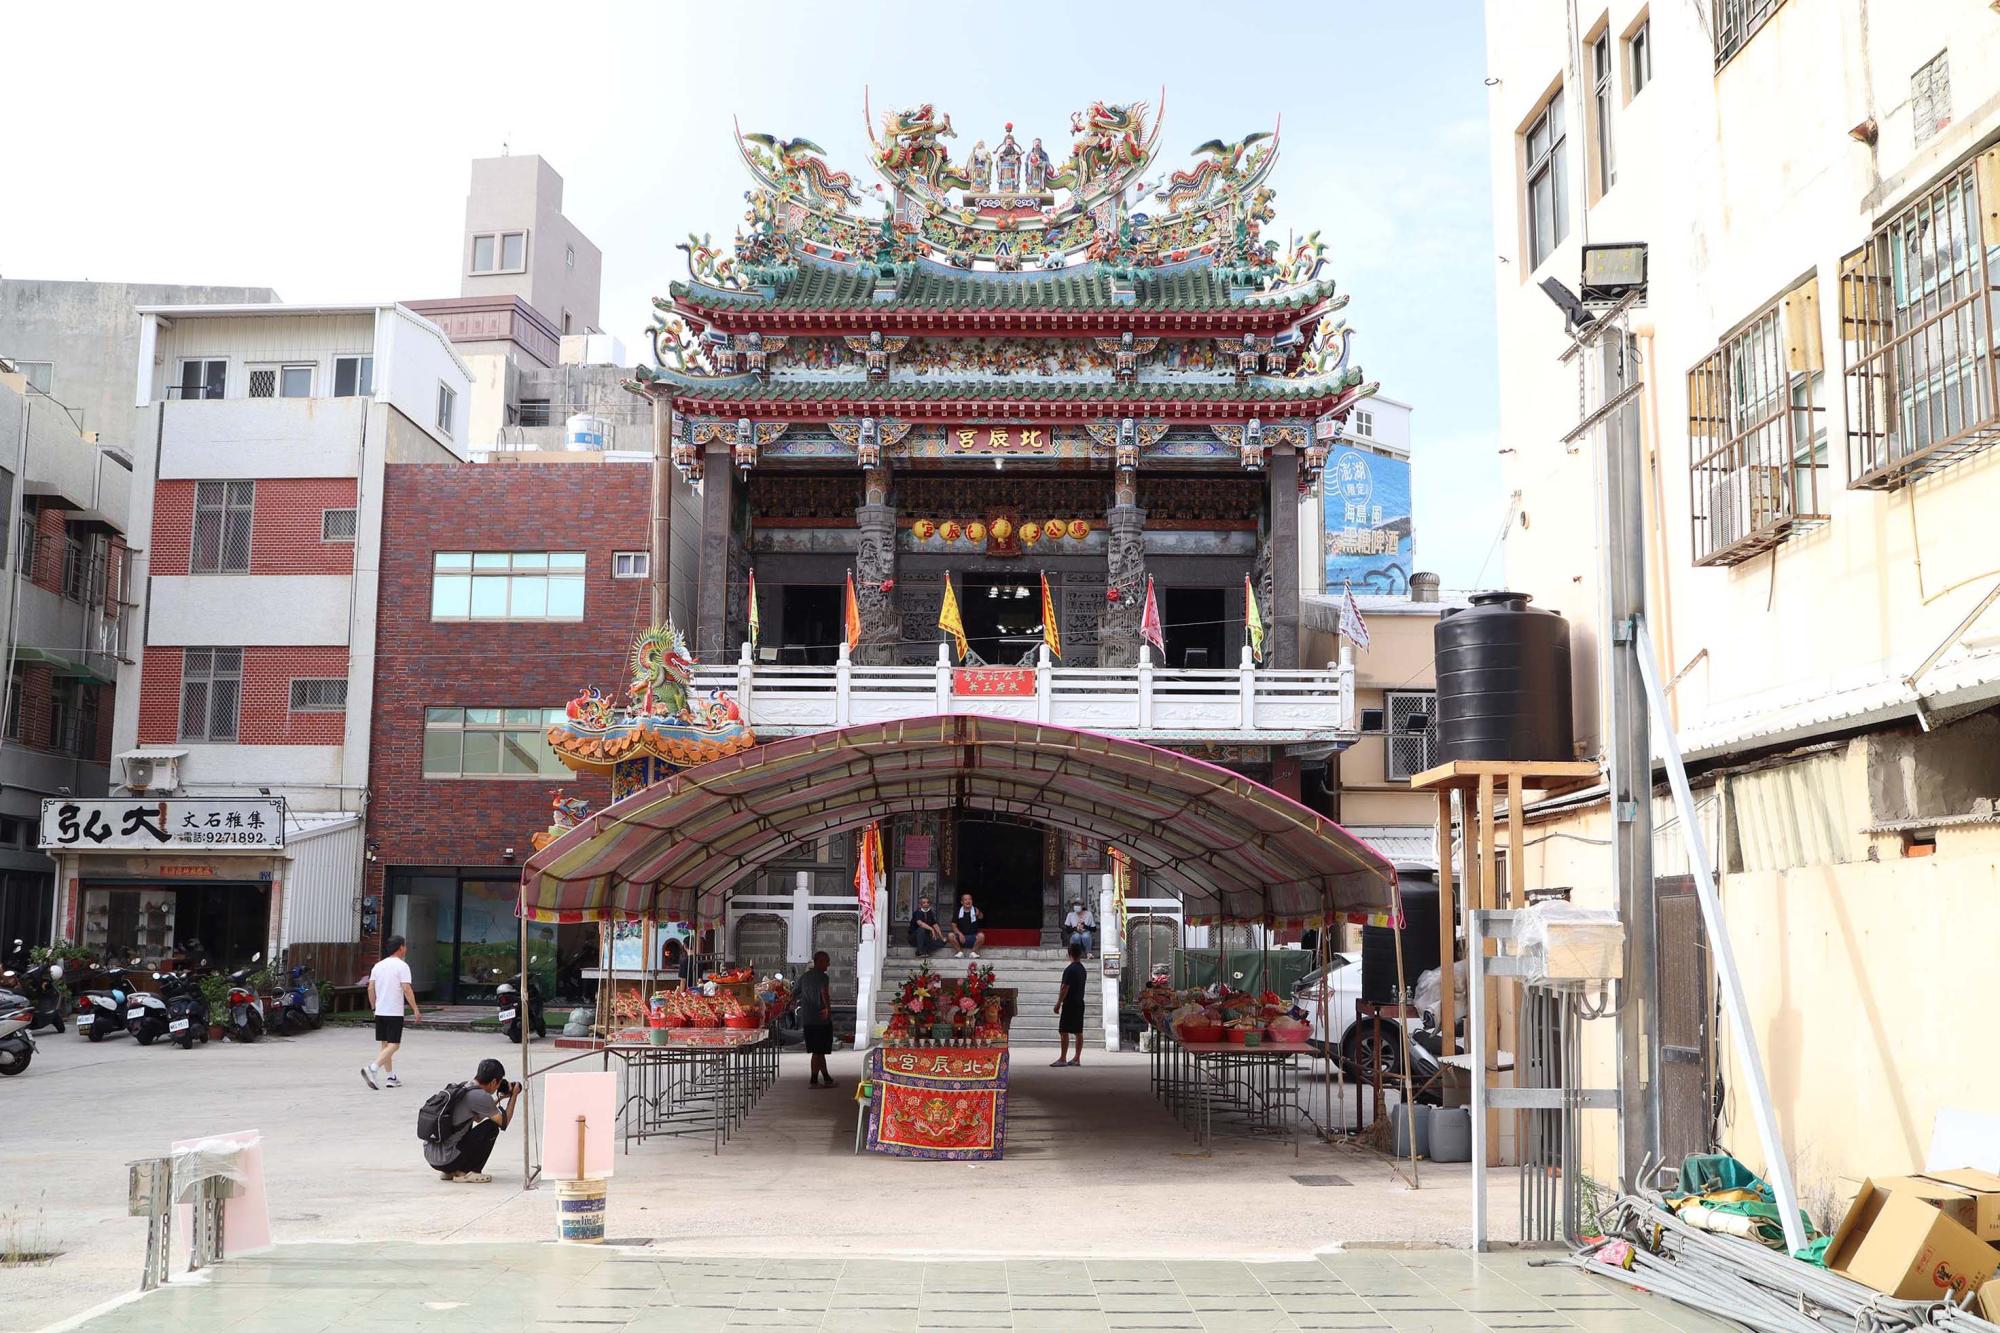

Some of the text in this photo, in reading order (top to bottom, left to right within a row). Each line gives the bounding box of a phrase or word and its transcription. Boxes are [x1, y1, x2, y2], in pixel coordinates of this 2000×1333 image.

[182, 811, 265, 830] 文石雅集
[900, 1054, 982, 1074] 北辰宮
